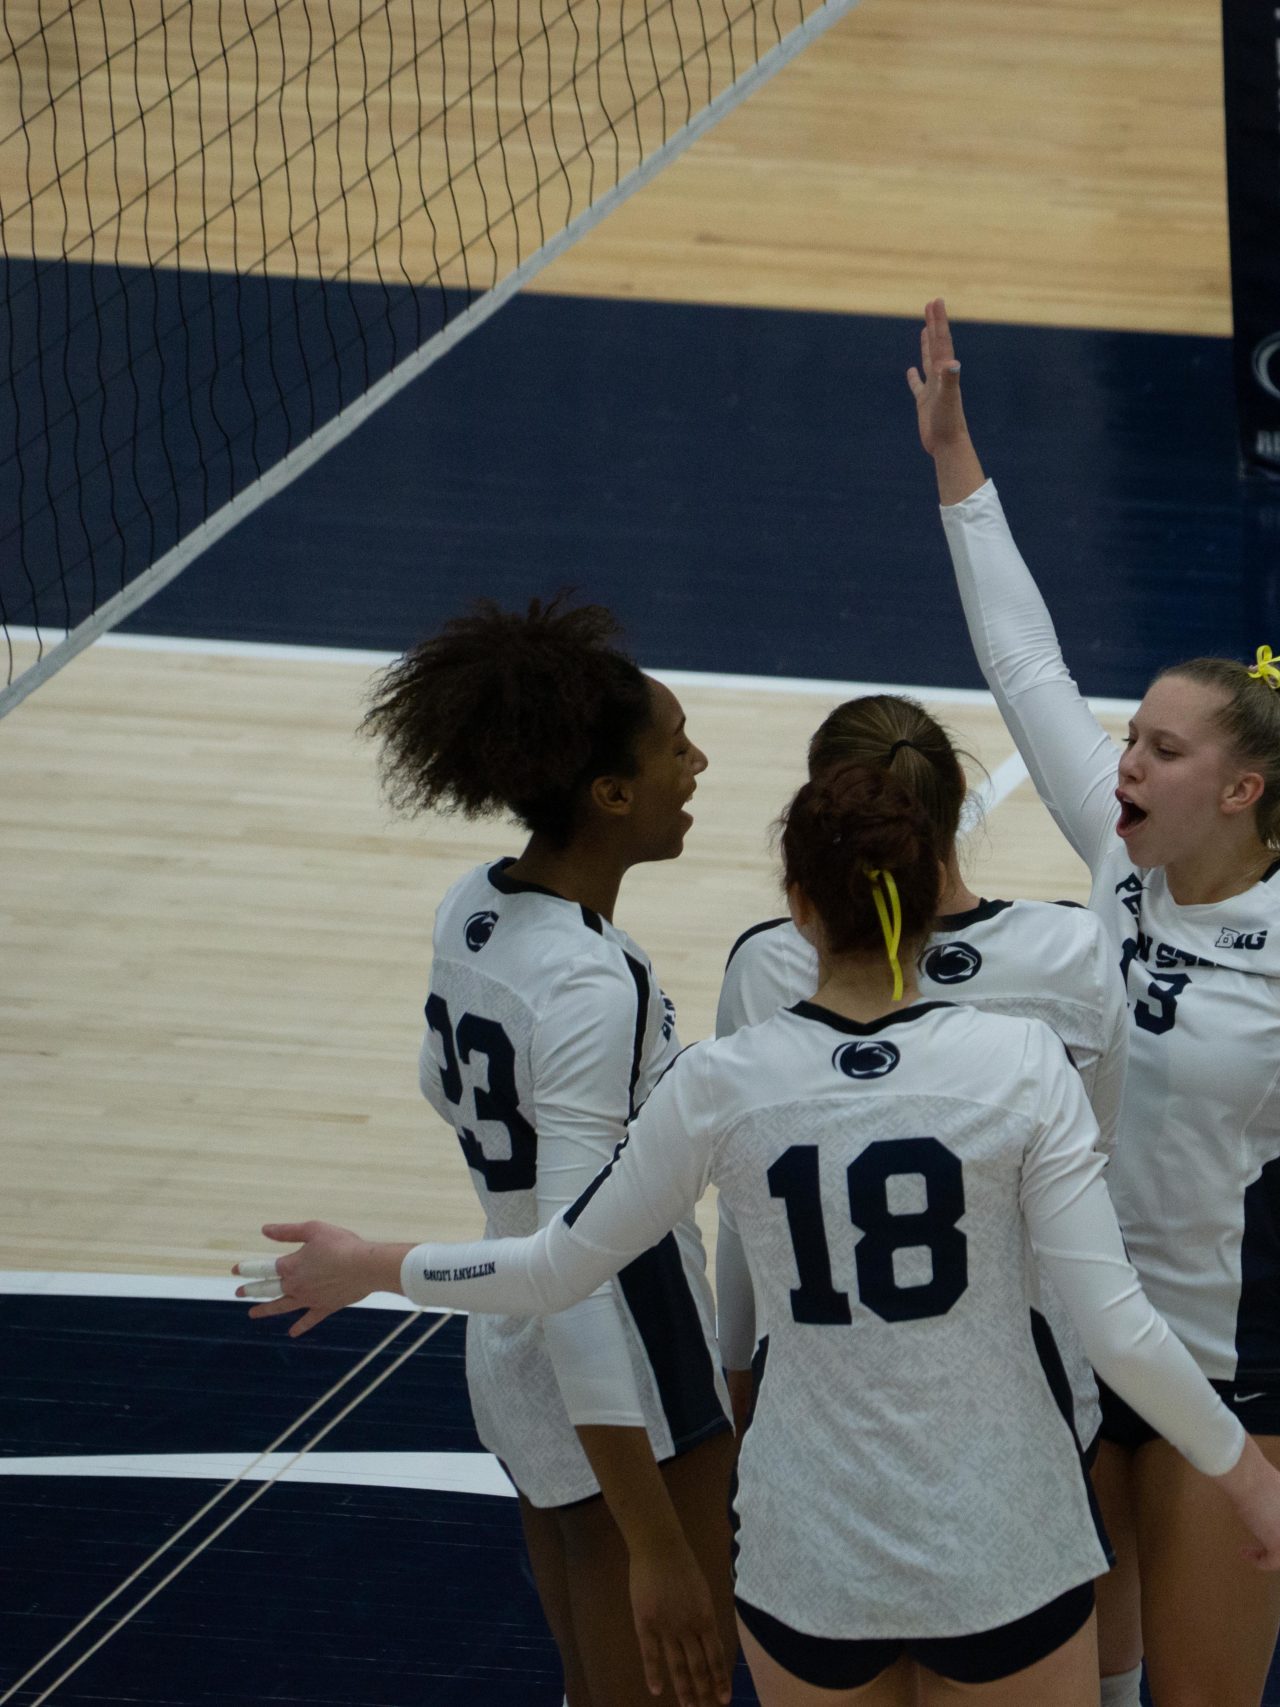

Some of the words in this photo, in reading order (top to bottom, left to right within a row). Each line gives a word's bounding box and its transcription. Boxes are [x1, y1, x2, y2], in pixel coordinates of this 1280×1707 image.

[766, 1136, 969, 1326] 18
[423, 1268, 452, 1282] LIONS
[453, 1261, 497, 1281] NITTANY
